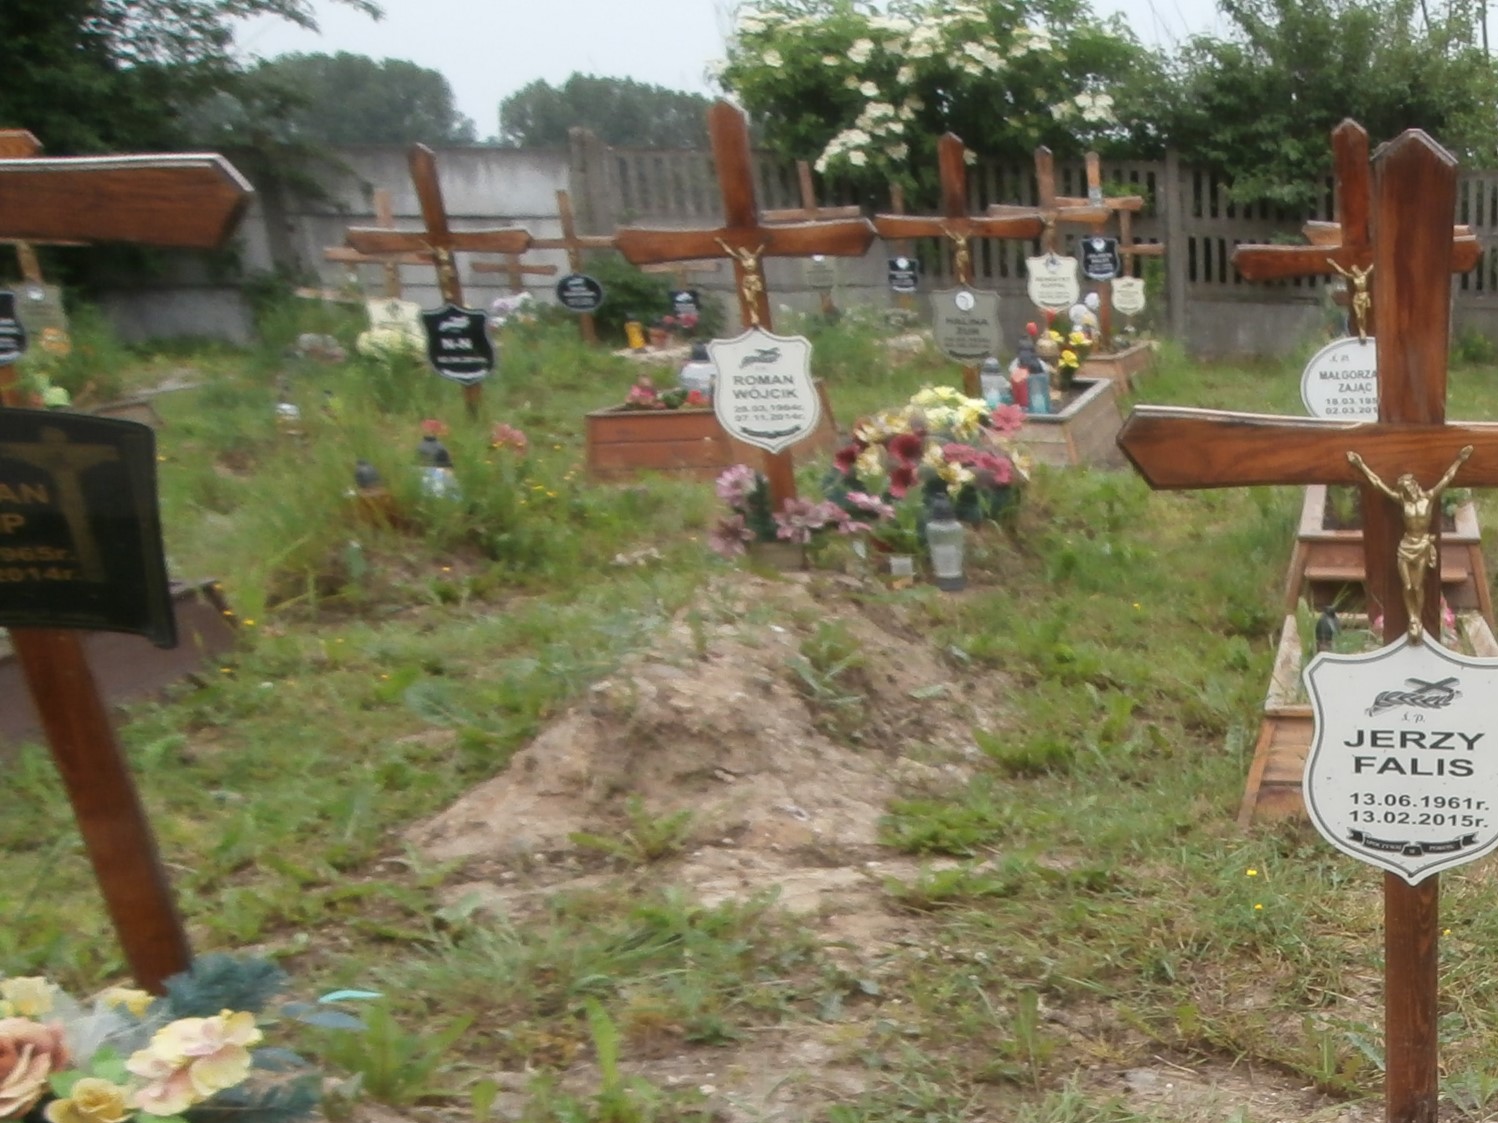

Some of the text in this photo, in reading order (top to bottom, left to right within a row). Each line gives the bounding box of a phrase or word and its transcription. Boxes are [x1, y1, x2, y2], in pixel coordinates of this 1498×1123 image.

[733, 375, 794, 385] ROMAN
[1338, 382, 1372, 394] ZAJĄC
[733, 386, 798, 399] WÓJCIK
[1343, 729, 1485, 750] JERZY
[1354, 756, 1474, 777] FALIS
[1350, 792, 1490, 811] 13.06.1961r.
[1349, 810, 1488, 828] 13.02.2015r.
